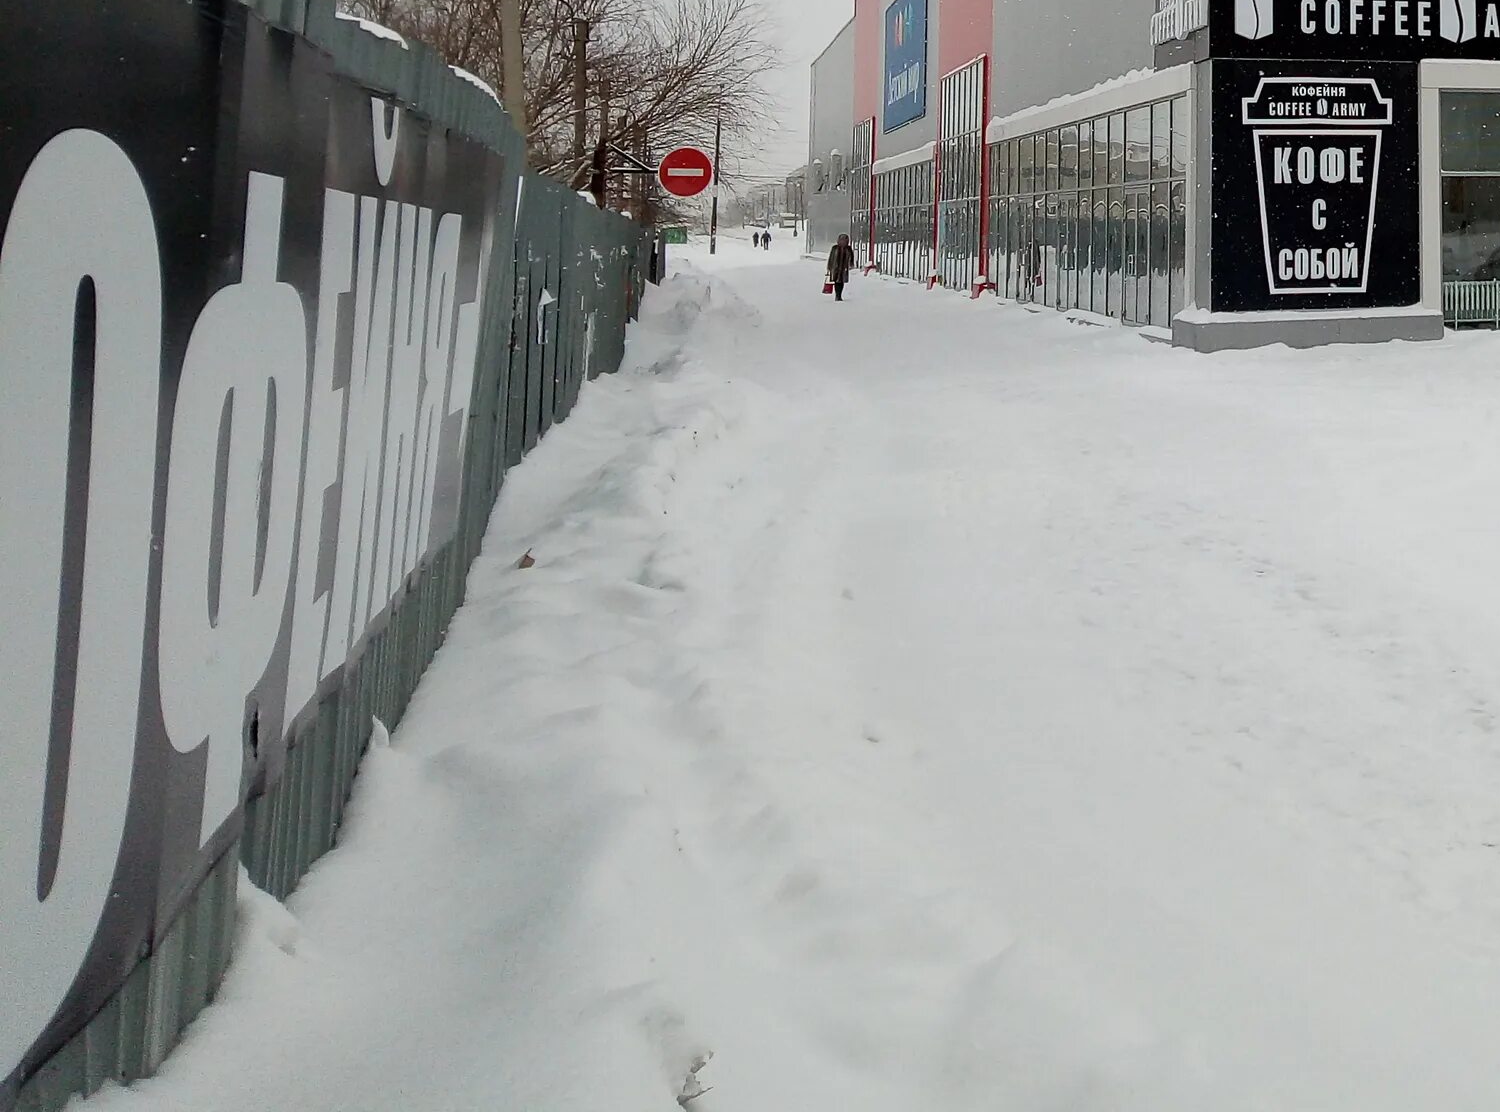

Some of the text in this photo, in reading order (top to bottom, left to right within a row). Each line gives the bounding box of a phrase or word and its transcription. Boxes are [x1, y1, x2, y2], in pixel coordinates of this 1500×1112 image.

[1291, 84, 1346, 98] КОФЕЙНЯ
[1268, 101, 1366, 117] COFFEE ARMY
[1274, 146, 1364, 184] КОФЕ
[1311, 198, 1327, 230] С
[1278, 242, 1358, 281] СОБОЙ
